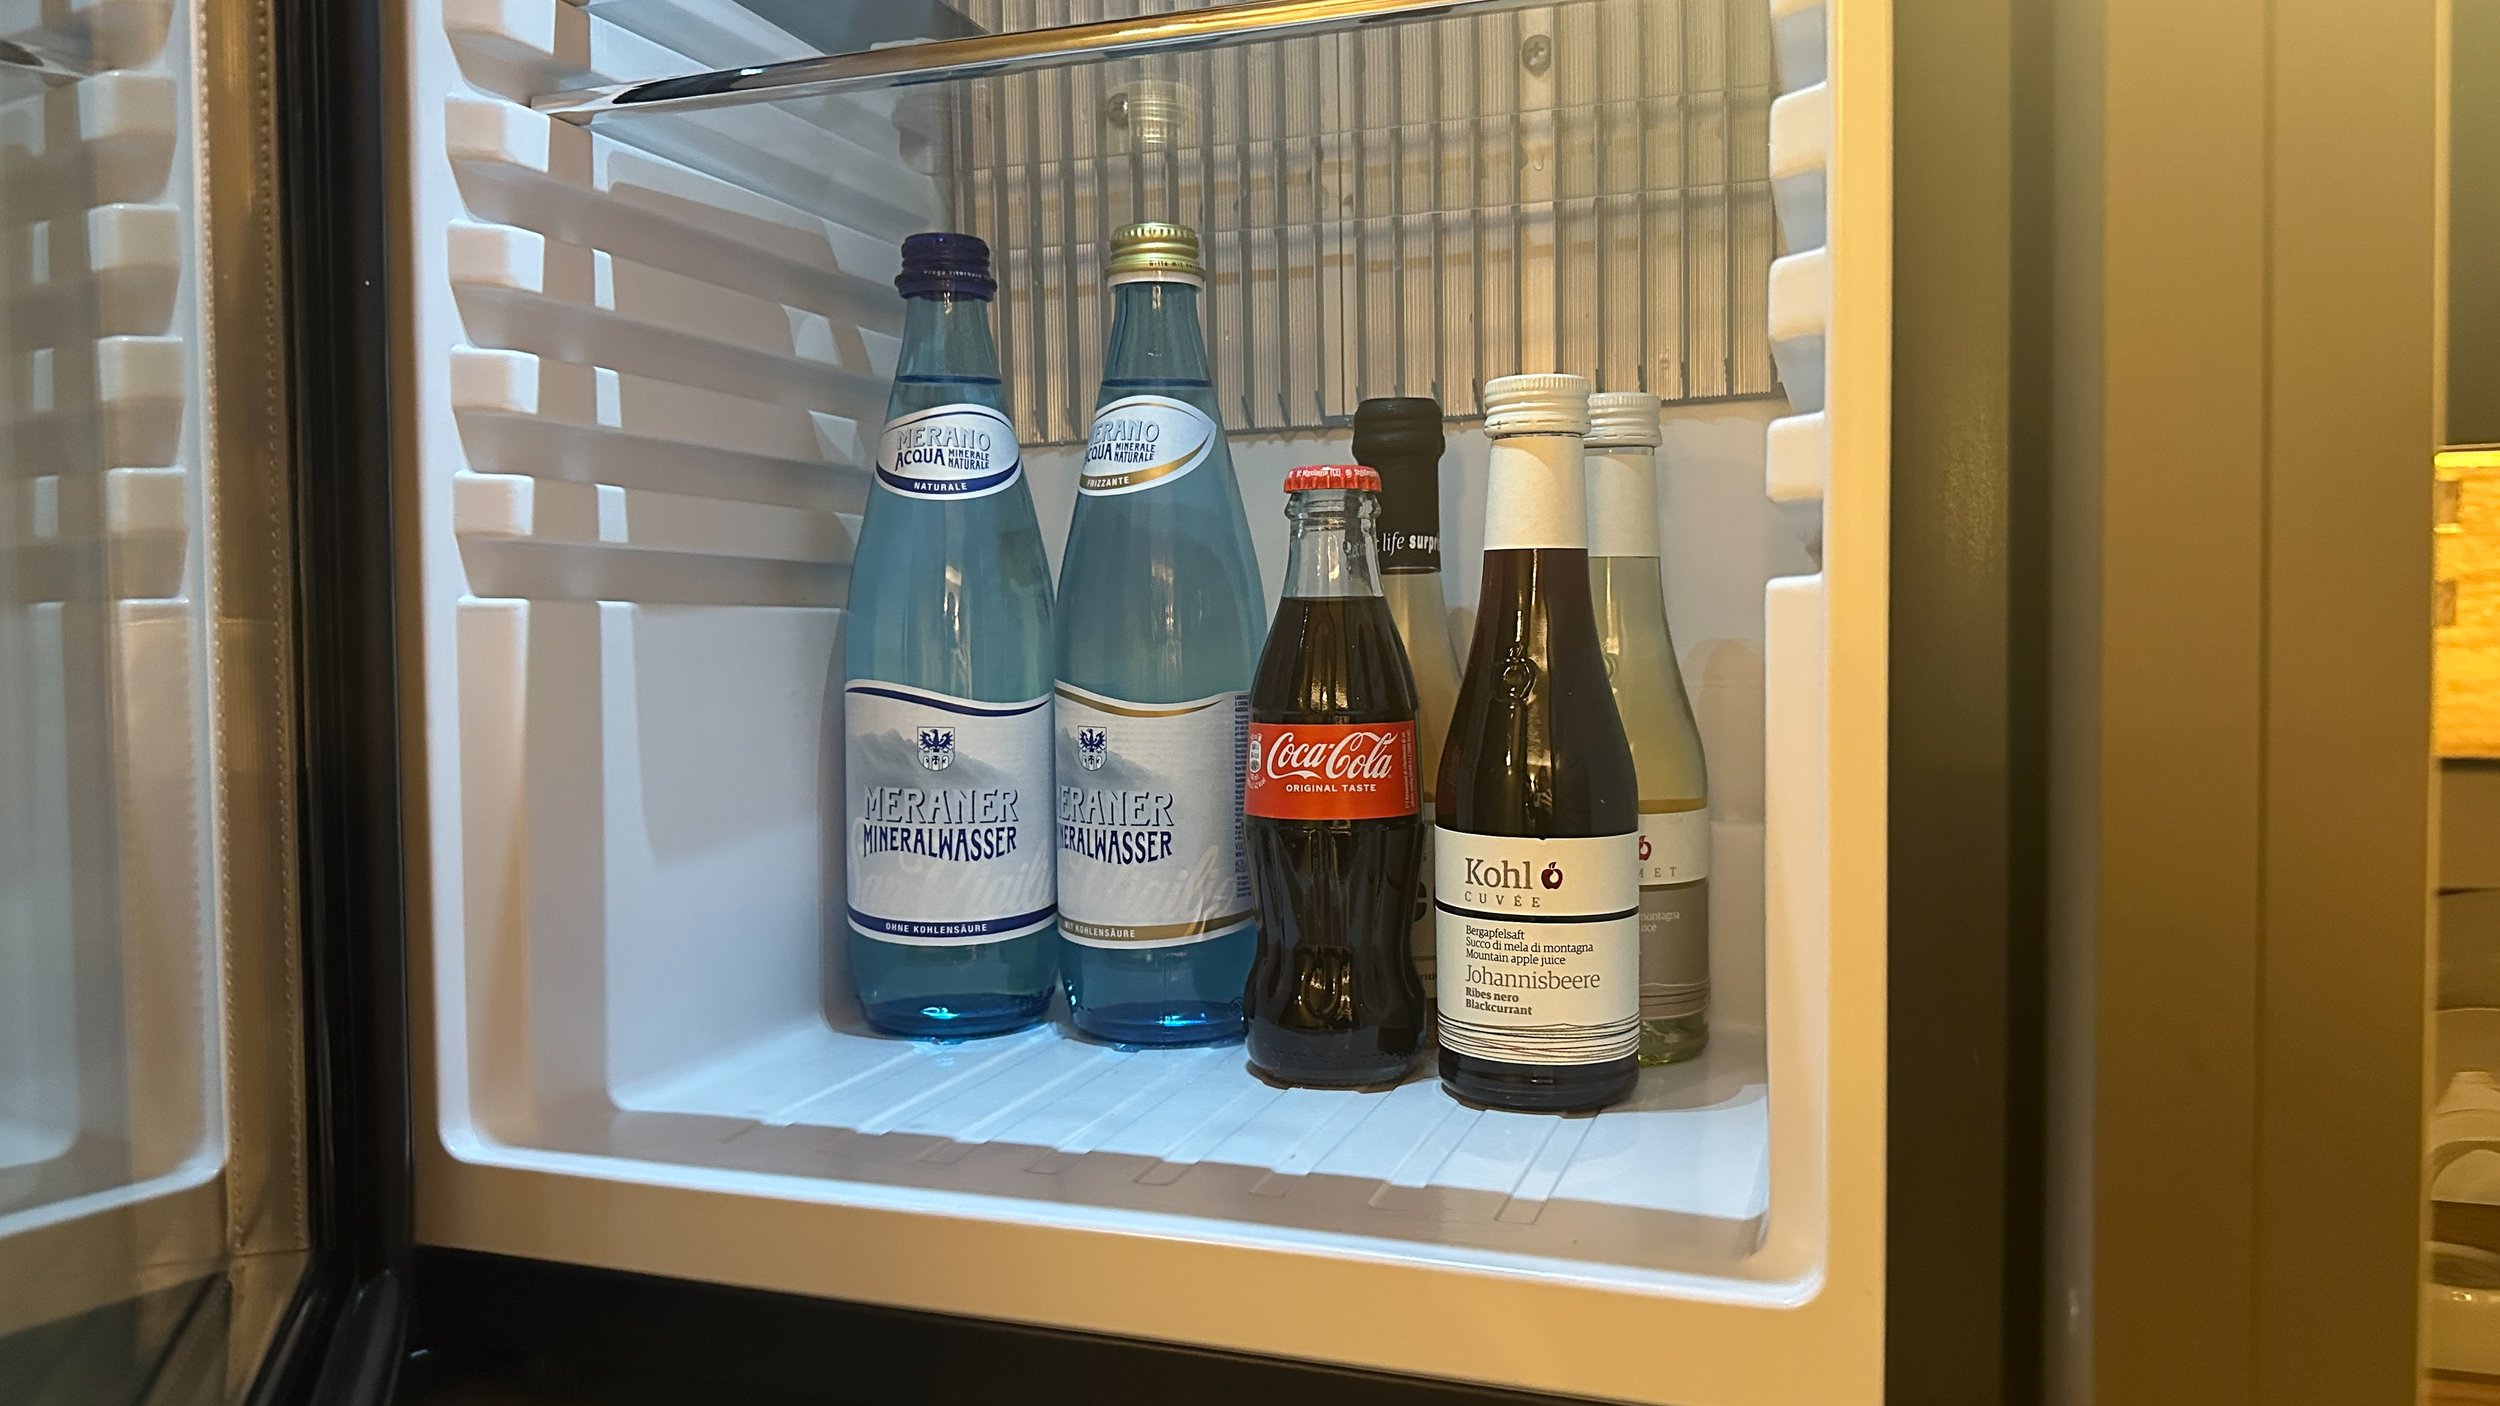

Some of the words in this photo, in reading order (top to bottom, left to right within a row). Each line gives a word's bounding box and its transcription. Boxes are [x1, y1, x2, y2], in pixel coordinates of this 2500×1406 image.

[896, 426, 992, 452] MERANO
[1115, 442, 1156, 454] MINERALE
[895, 448, 946, 472] ACQUA
[948, 448, 990, 461] MINERALE
[948, 459, 990, 471] NATURALE
[1114, 451, 1155, 464] NATURALE
[913, 481, 968, 492] NATURALE
[1086, 476, 1130, 488] FRIZZANTE
[1382, 531, 1405, 557] life
[1266, 731, 1399, 780] Coca-Cola
[1285, 783, 1338, 793] ORIGINAL
[1341, 783, 1377, 793] TASTE
[864, 784, 1020, 825] MERANER
[1057, 785, 1175, 827] ERANER
[863, 824, 1018, 863] MINERALWASSER
[1465, 857, 1533, 890] Kohl
[1464, 890, 1541, 908] CUVÉE
[885, 922, 910, 933] OHNE
[913, 921, 988, 934] KOHLENSÄURE
[1075, 922, 1136, 938] KOHLENSÄURE
[1465, 924, 1525, 940] Bergapfelsaft
[1465, 937, 1491, 950] Succo
[1492, 938, 1502, 951] di
[1504, 941, 1529, 953] mela
[1531, 942, 1541, 953] di
[1543, 943, 1594, 955] montagna
[1465, 947, 1509, 963] Mountain
[1510, 953, 1539, 966] apple
[1540, 955, 1566, 967] juice
[1465, 964, 1601, 990] Johannisbeere
[1465, 986, 1492, 1000] Ribes
[1493, 991, 1520, 1003] nero
[1465, 998, 1533, 1016] Blackcurrant
